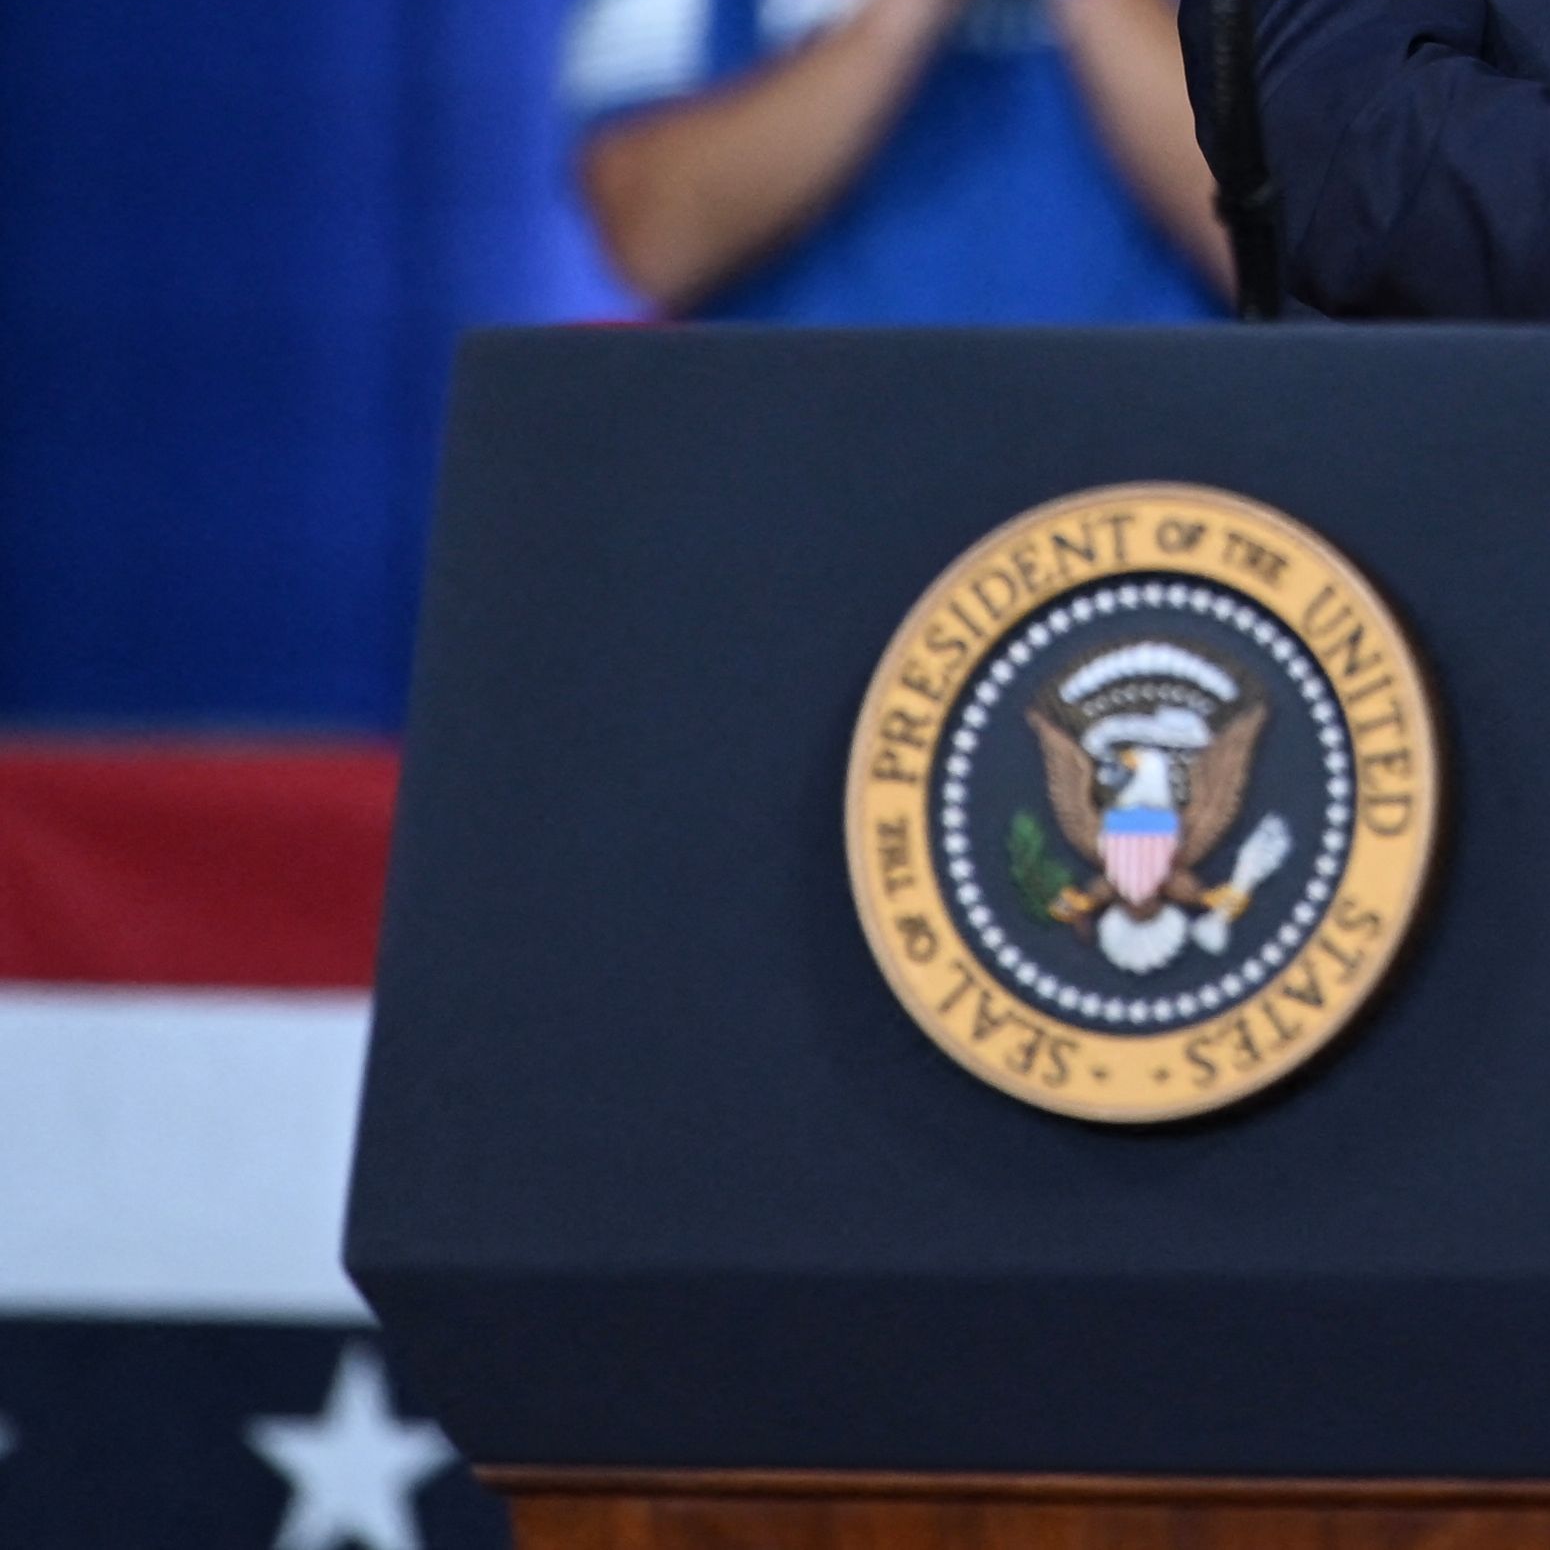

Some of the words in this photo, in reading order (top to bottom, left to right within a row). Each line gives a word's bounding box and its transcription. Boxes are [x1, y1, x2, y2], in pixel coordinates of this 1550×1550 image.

[1156, 519, 1207, 553] OF
[1222, 533, 1291, 589] THE
[872, 514, 1136, 787] PRESIDENT
[1304, 586, 1413, 838] UNITED
[875, 816, 917, 897] THE
[894, 913, 937, 963] OF
[935, 959, 1083, 1089] SEAL
[1183, 897, 1382, 1089] STATES
